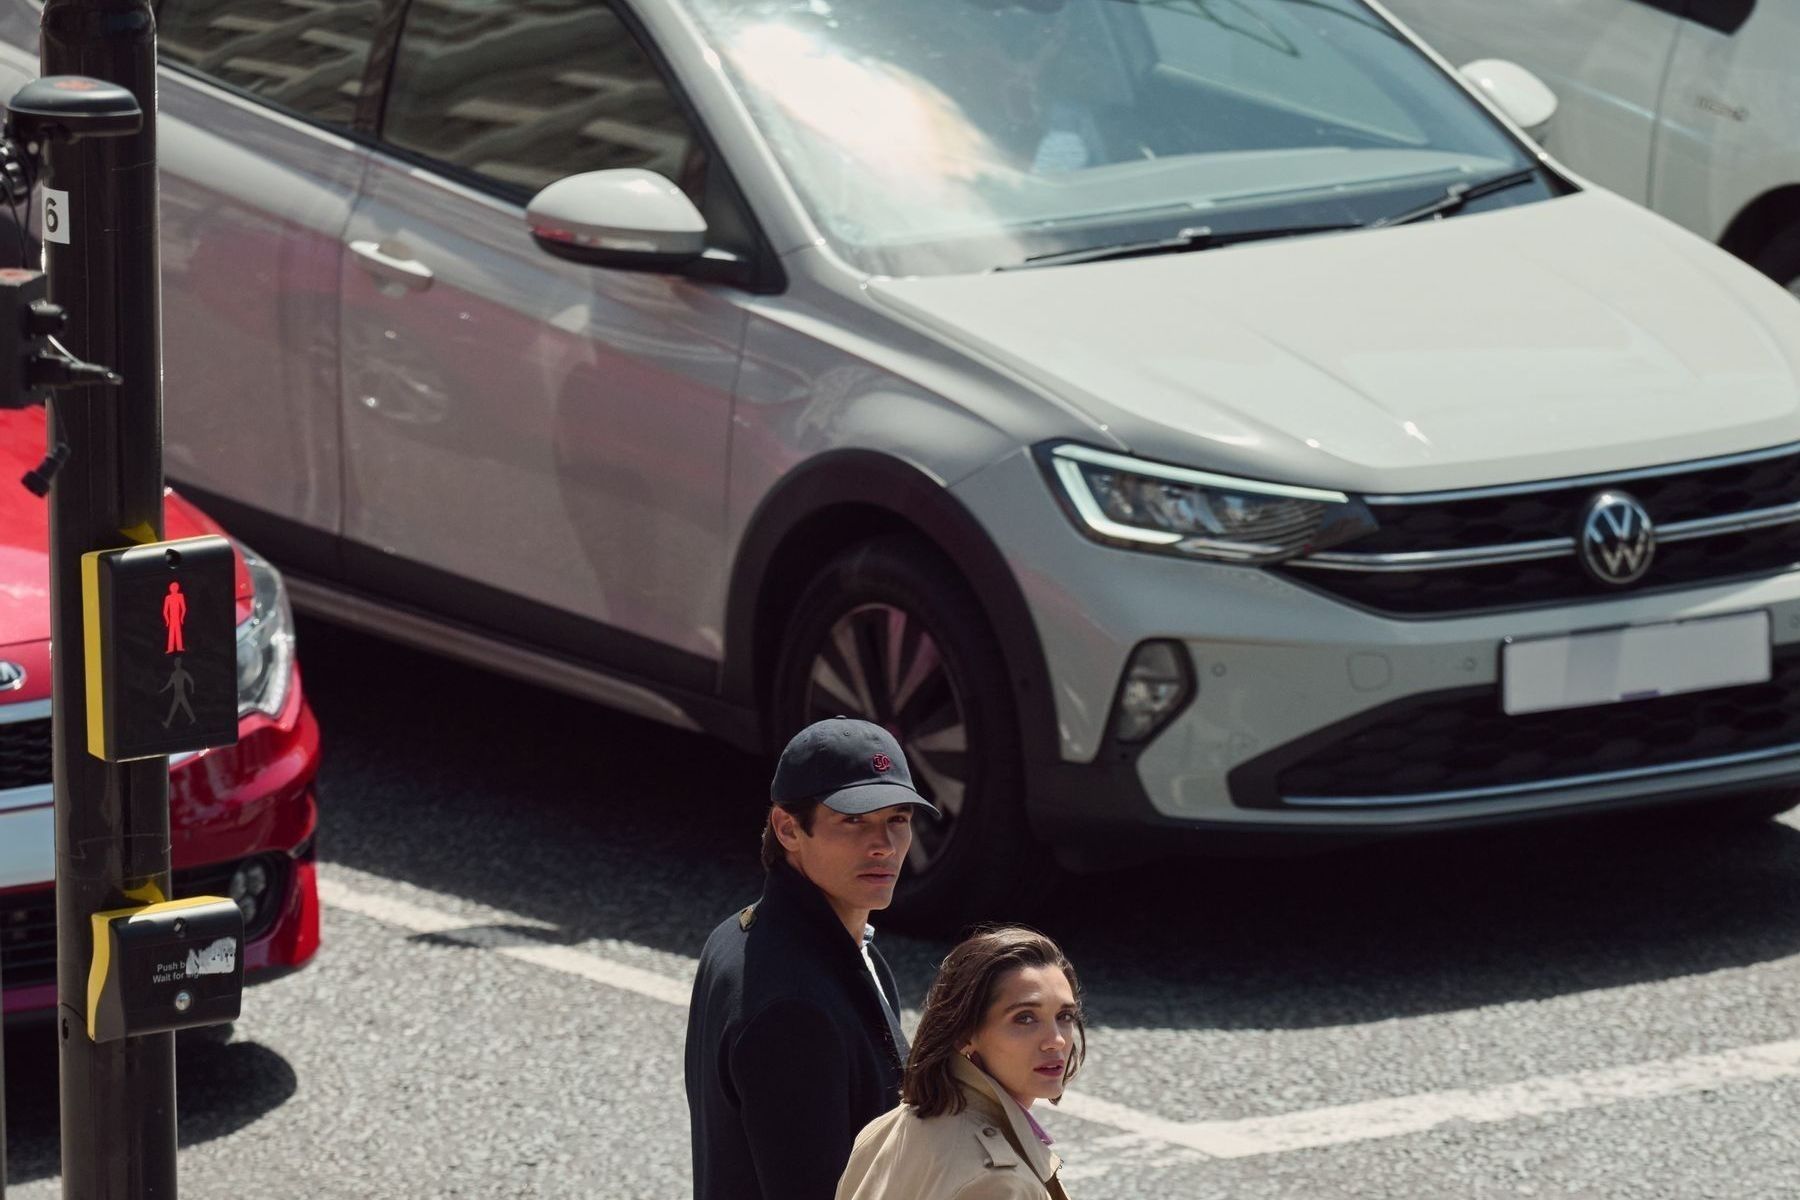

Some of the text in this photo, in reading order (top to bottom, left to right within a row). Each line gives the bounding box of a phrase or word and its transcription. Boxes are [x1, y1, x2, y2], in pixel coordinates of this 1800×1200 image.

[45, 197, 58, 233] 6
[157, 961, 178, 973] Push
[152, 973, 171, 984] Wait
[173, 971, 185, 981] for
